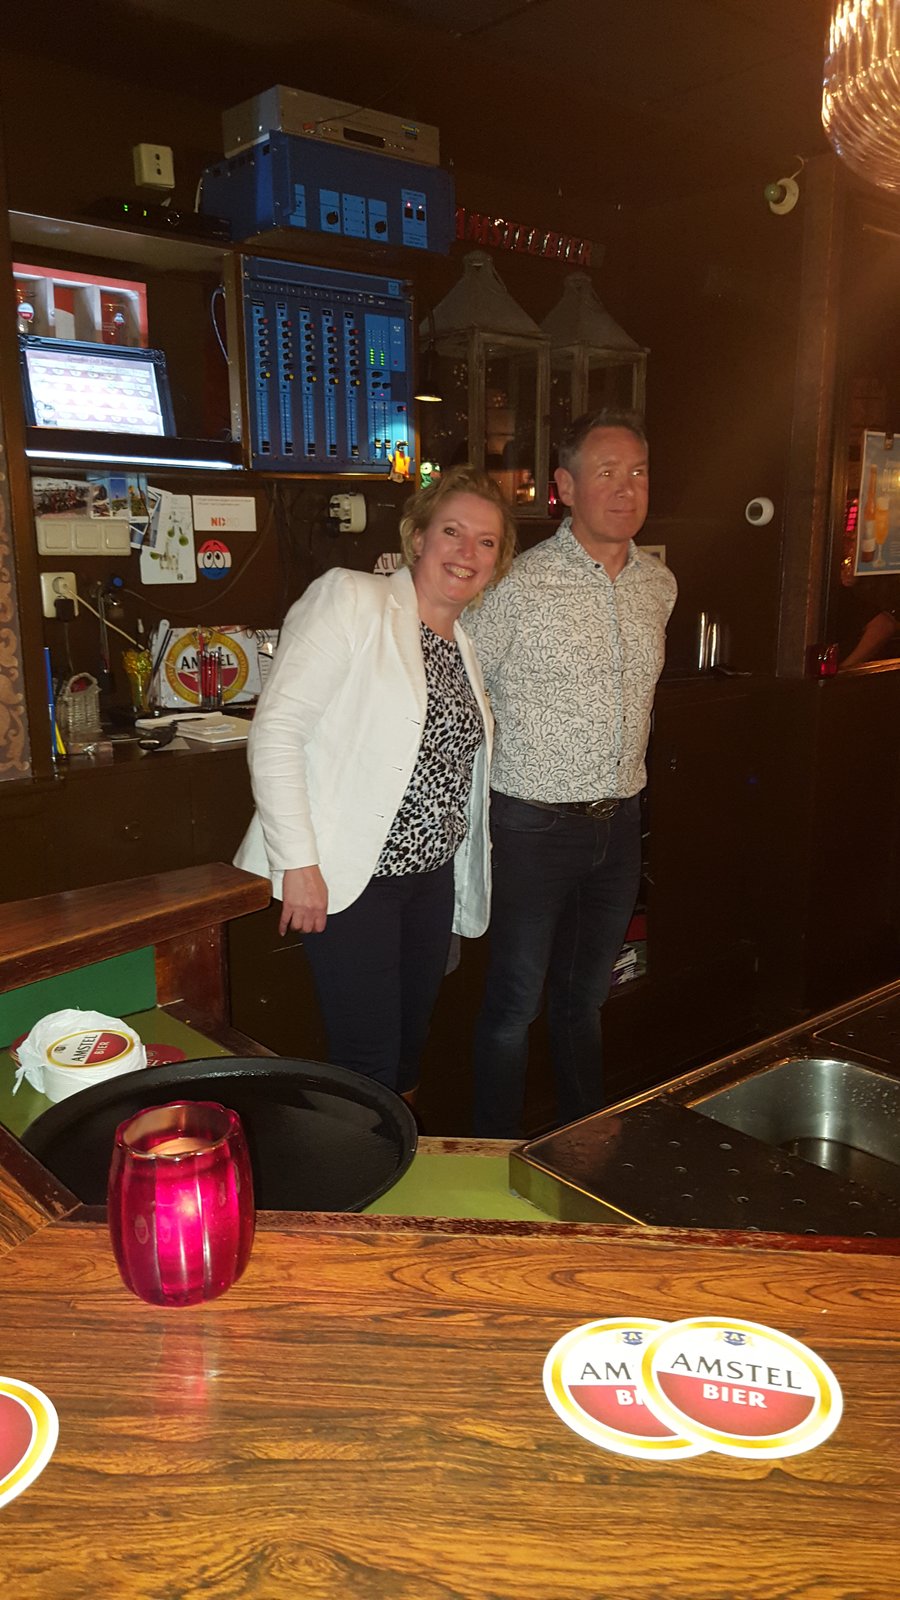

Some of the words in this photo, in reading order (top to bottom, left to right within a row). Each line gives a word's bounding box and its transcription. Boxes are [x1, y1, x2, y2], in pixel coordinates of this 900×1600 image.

[71, 1034, 98, 1062] AMSTEL
[93, 1041, 111, 1055] BIER
[580, 1362, 632, 1380] AM
[670, 1352, 802, 1390] AMSTEL
[702, 1383, 767, 1409] BIER
